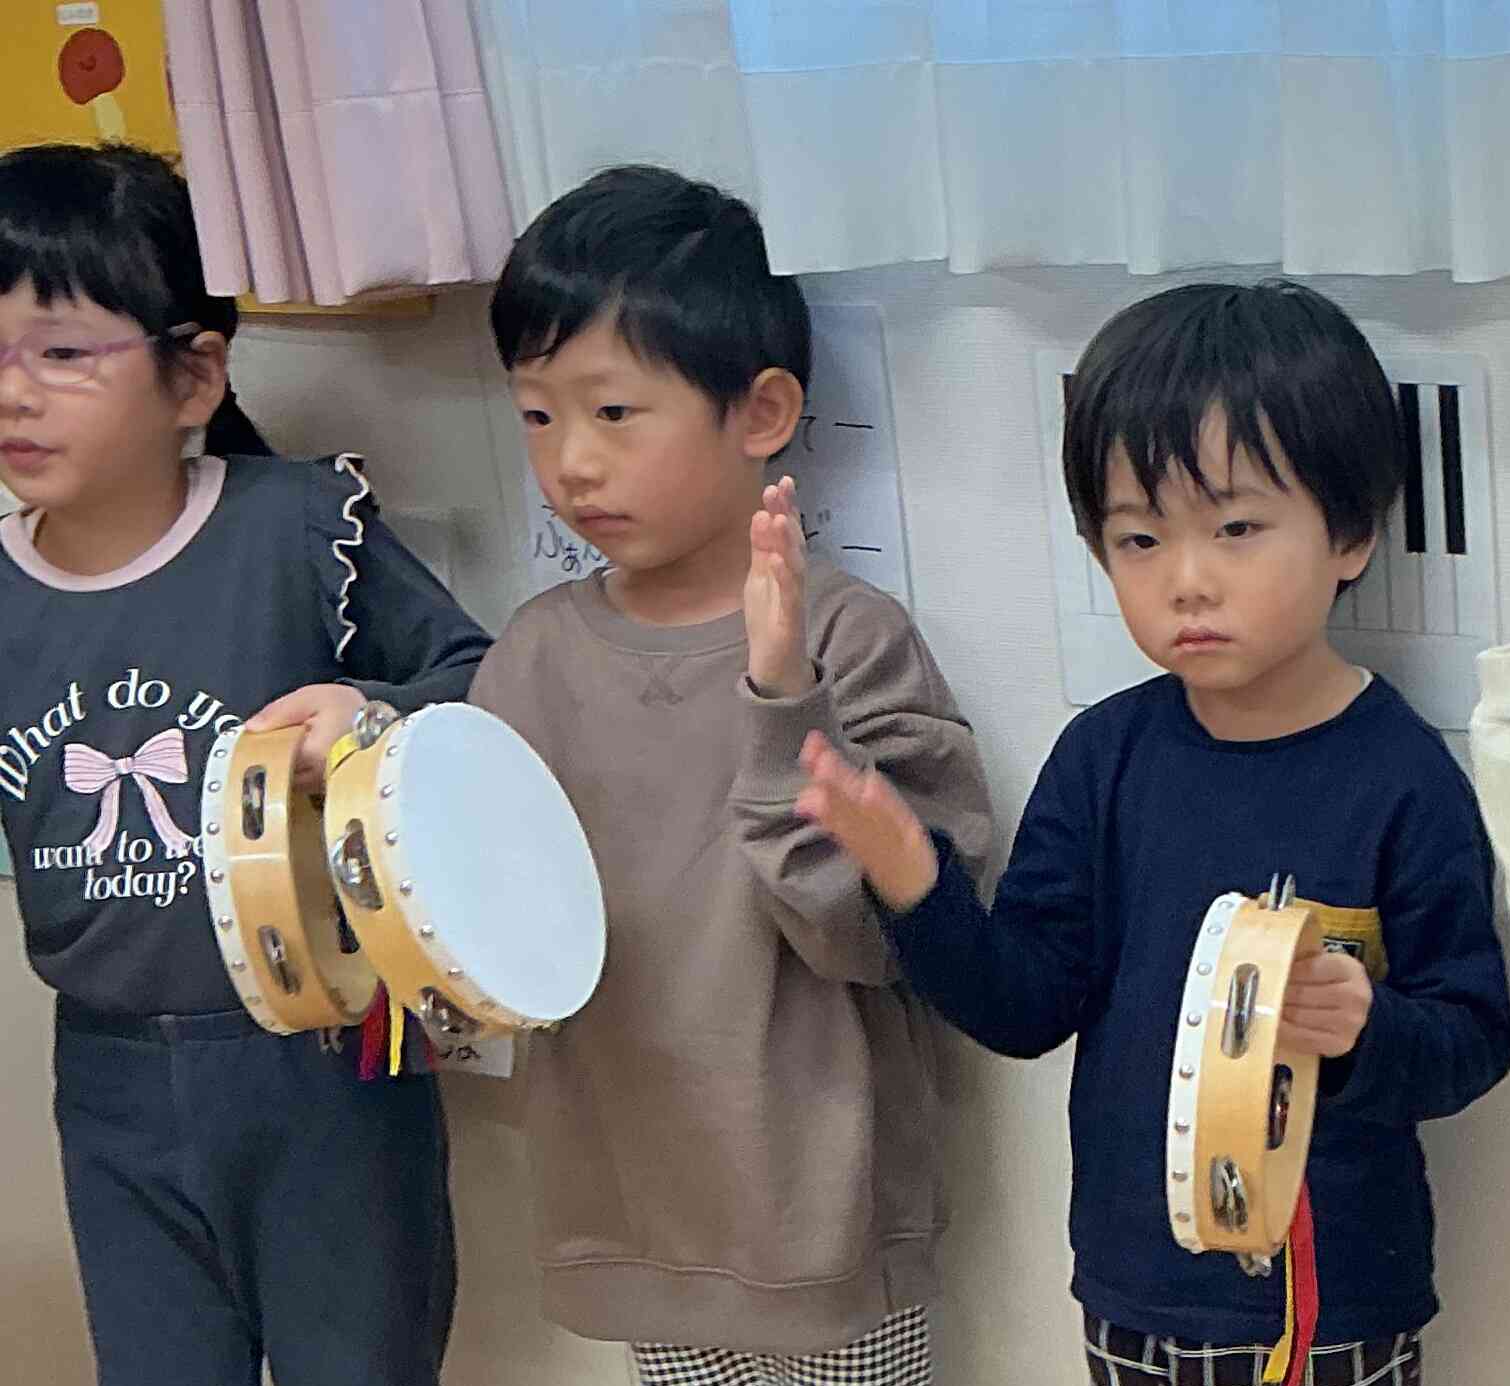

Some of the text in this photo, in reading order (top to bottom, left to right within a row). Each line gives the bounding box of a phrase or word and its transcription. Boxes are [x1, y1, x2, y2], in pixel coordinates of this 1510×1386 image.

[0, 682, 87, 801] What
[107, 668, 171, 709] do
[118, 830, 153, 864] to
[84, 861, 196, 908] today?
